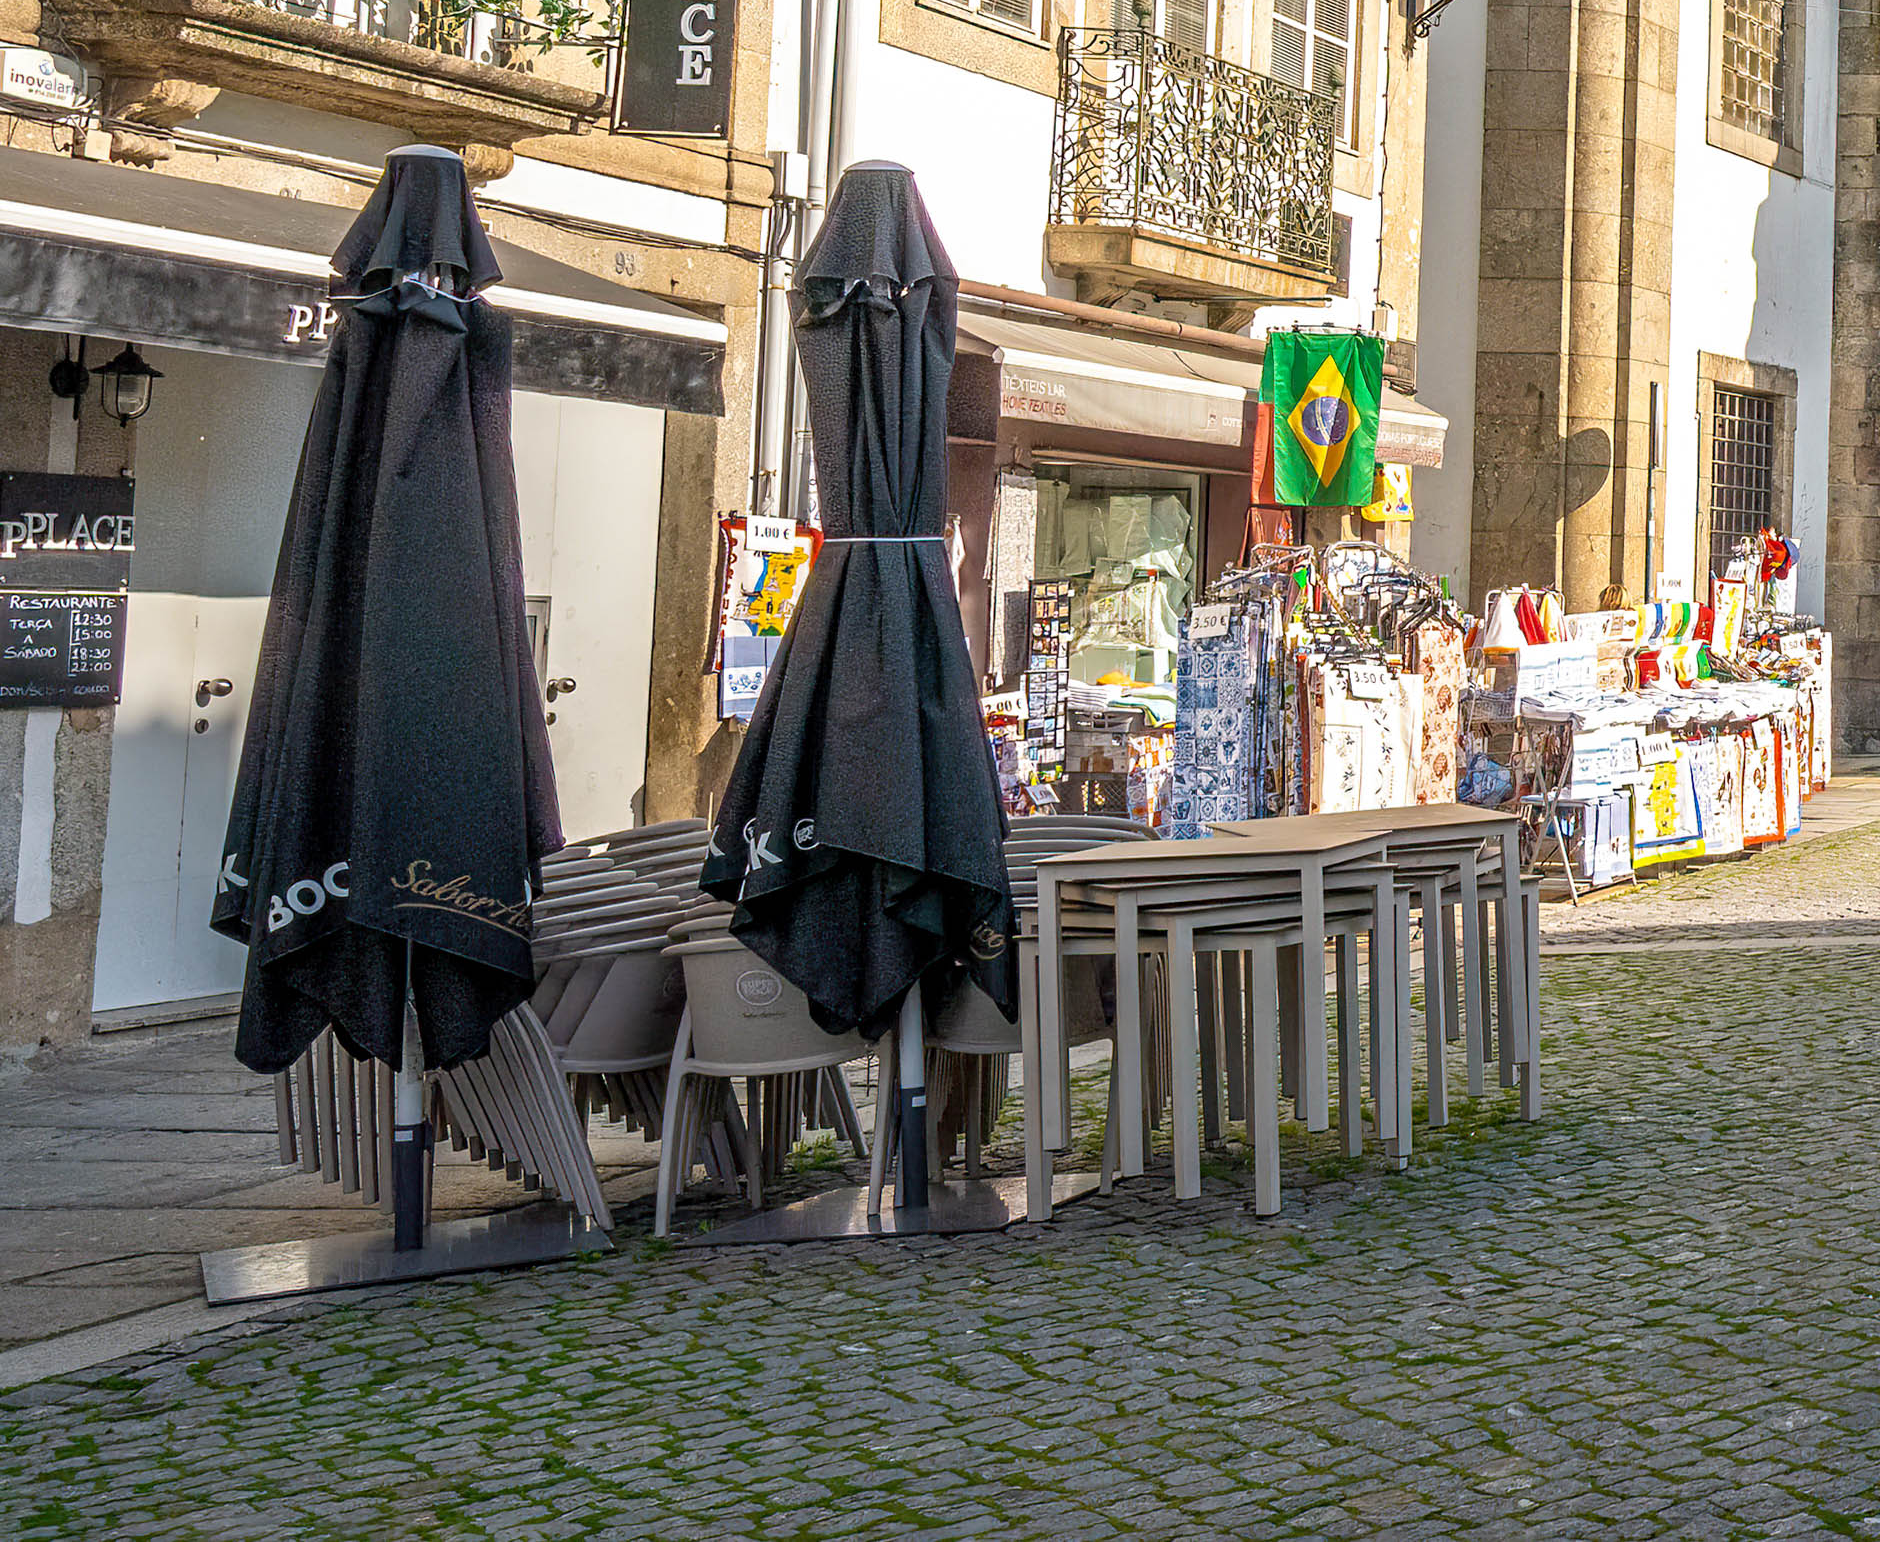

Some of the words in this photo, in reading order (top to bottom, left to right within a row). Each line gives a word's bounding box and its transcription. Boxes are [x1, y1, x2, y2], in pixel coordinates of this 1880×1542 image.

[1047, 381, 1067, 399] LAR
[754, 524, 780, 539] 1.00
[9, 594, 118, 610] RESTAURANTE
[73, 613, 113, 627] 12:30
[1192, 616, 1217, 630] 3.50
[1219, 616, 1228, 627] €
[74, 628, 113, 642] 15:00
[70, 647, 111, 660] 18:30
[70, 661, 113, 673] 22:00
[1353, 670, 1378, 684] 3.50
[1379, 672, 1387, 685] €
[390, 859, 495, 912] Sabor
